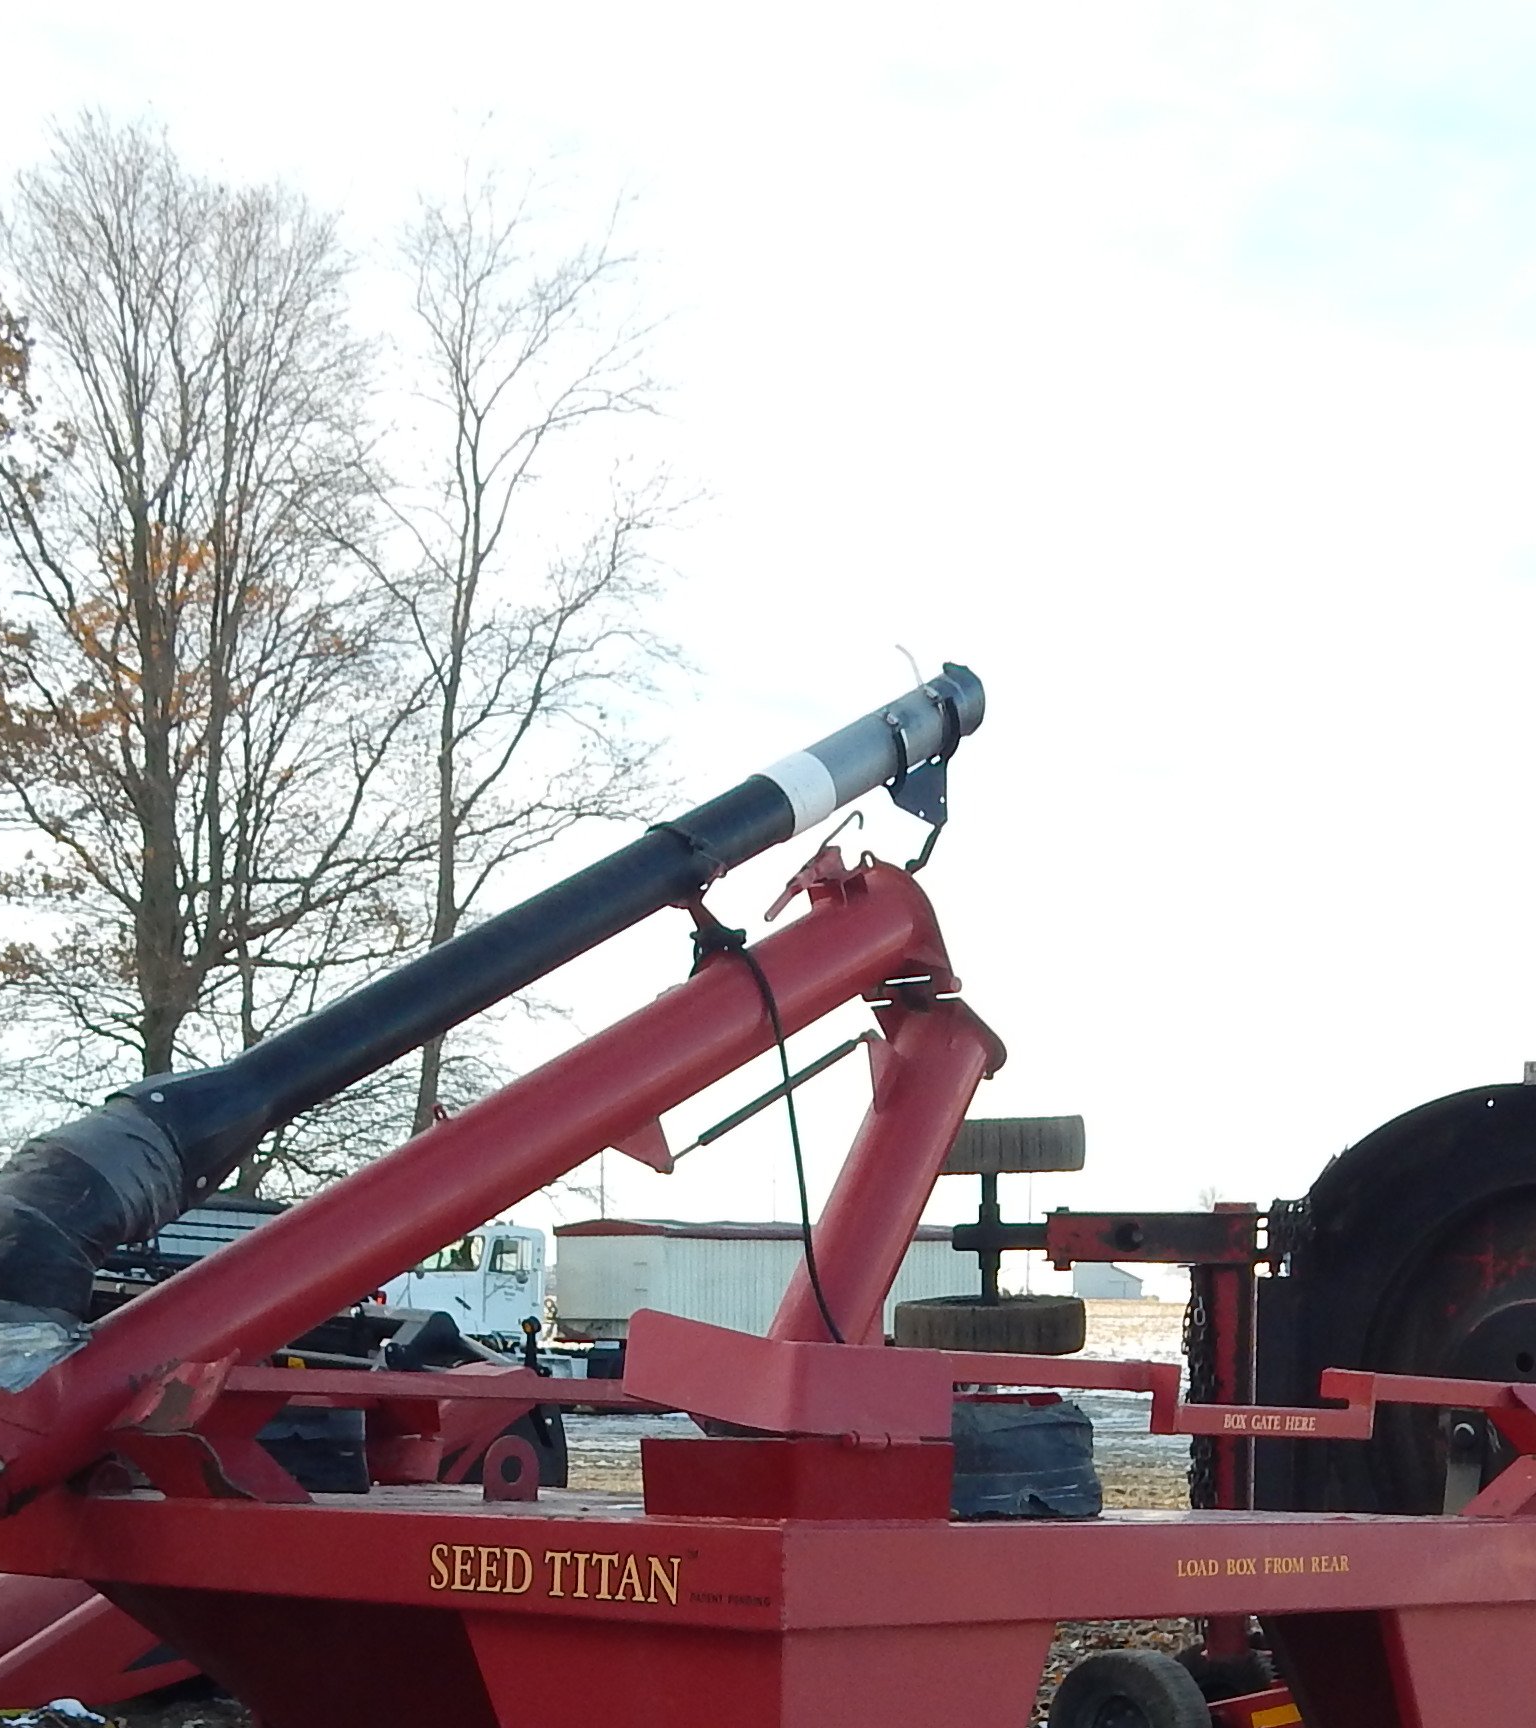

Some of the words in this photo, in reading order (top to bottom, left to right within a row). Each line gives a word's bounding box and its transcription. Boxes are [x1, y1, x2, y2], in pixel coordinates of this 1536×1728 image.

[1224, 1414, 1247, 1430] BOX
[1251, 1414, 1281, 1430] GATE
[1285, 1416, 1316, 1431] HERE
[429, 1543, 533, 1594] SEED
[545, 1550, 681, 1606] TITAN
[1178, 1559, 1219, 1577] LOAD
[1227, 1559, 1257, 1576] BOX
[1264, 1557, 1304, 1574] FROM
[1311, 1555, 1350, 1573] REAR
